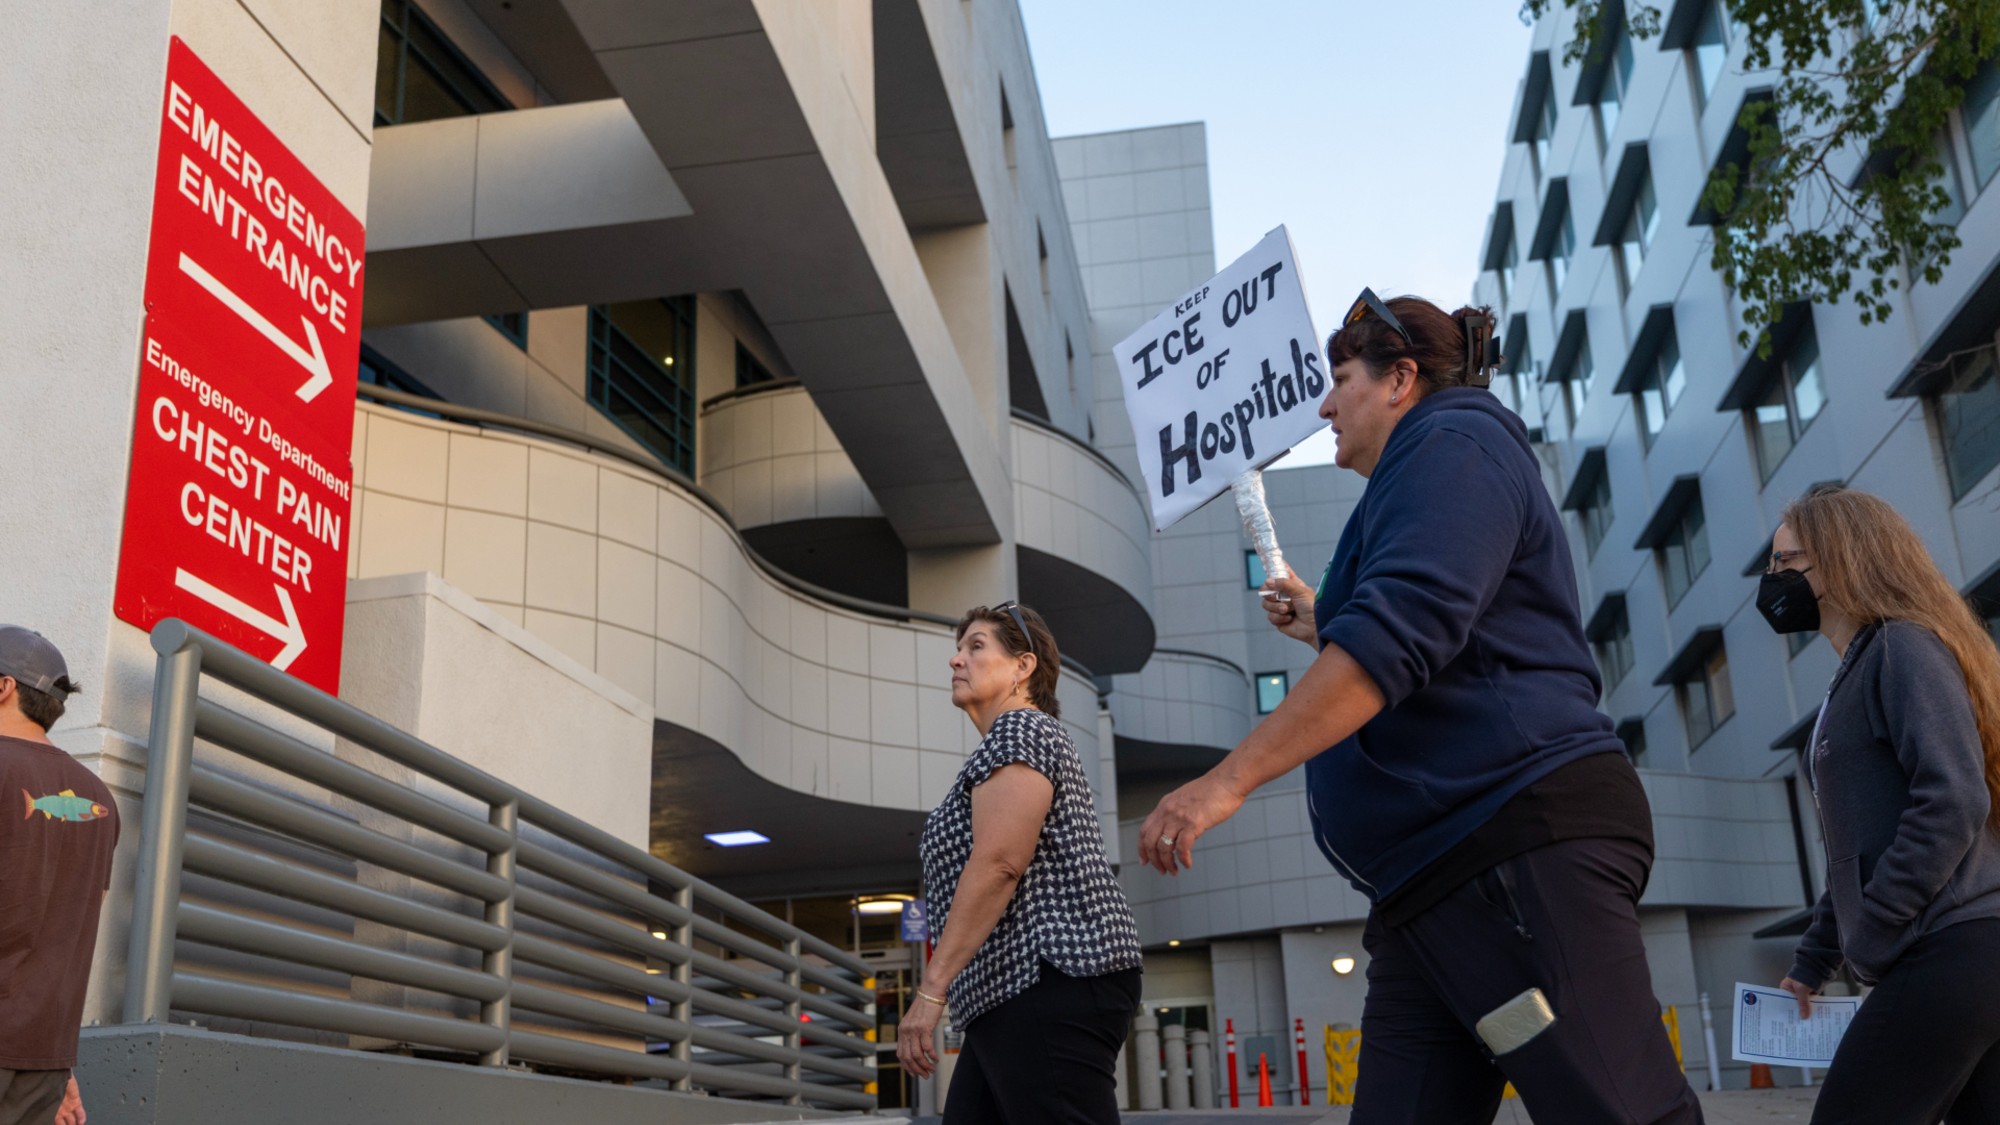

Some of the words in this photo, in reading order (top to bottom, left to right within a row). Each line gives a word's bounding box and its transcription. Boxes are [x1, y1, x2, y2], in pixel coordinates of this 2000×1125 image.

[168, 80, 362, 288] EMERGENCY
[178, 153, 347, 334] ENTRANCE
[1132, 311, 1204, 390] ICE
[1222, 261, 1283, 328] OUT
[1175, 286, 1210, 318] KEEP
[1196, 348, 1230, 390] OF
[146, 337, 255, 435] Emergency
[259, 418, 349, 501] Department
[152, 396, 270, 500] CHEST
[276, 476, 341, 551] PAIN
[1159, 338, 1324, 497] Hospitals
[181, 482, 312, 593] CENTER
